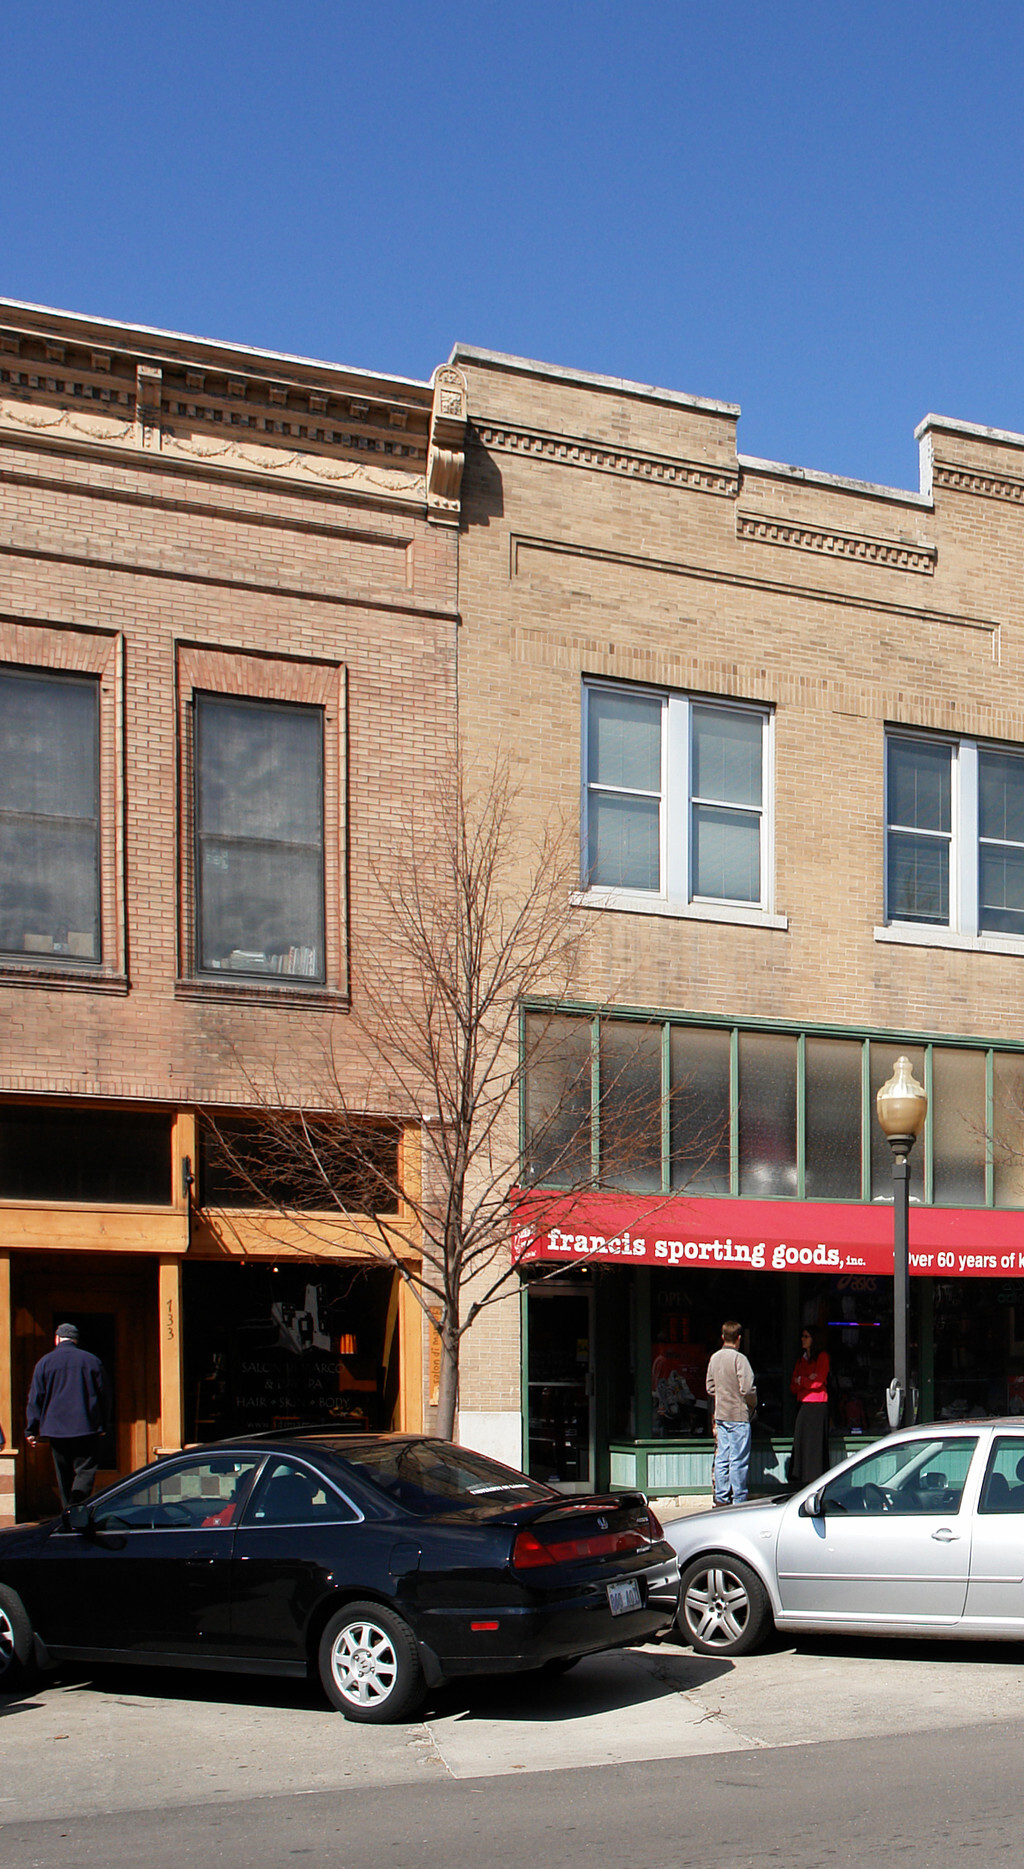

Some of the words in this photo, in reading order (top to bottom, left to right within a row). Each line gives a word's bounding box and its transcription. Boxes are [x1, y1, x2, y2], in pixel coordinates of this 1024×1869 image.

[547, 1228, 647, 1256] francis
[654, 1238, 766, 1268] sporting
[771, 1243, 845, 1270] goods,
[845, 1255, 867, 1267] inc.
[937, 1251, 955, 1268] 60
[958, 1253, 998, 1272] years
[1000, 1252, 1016, 1269] of
